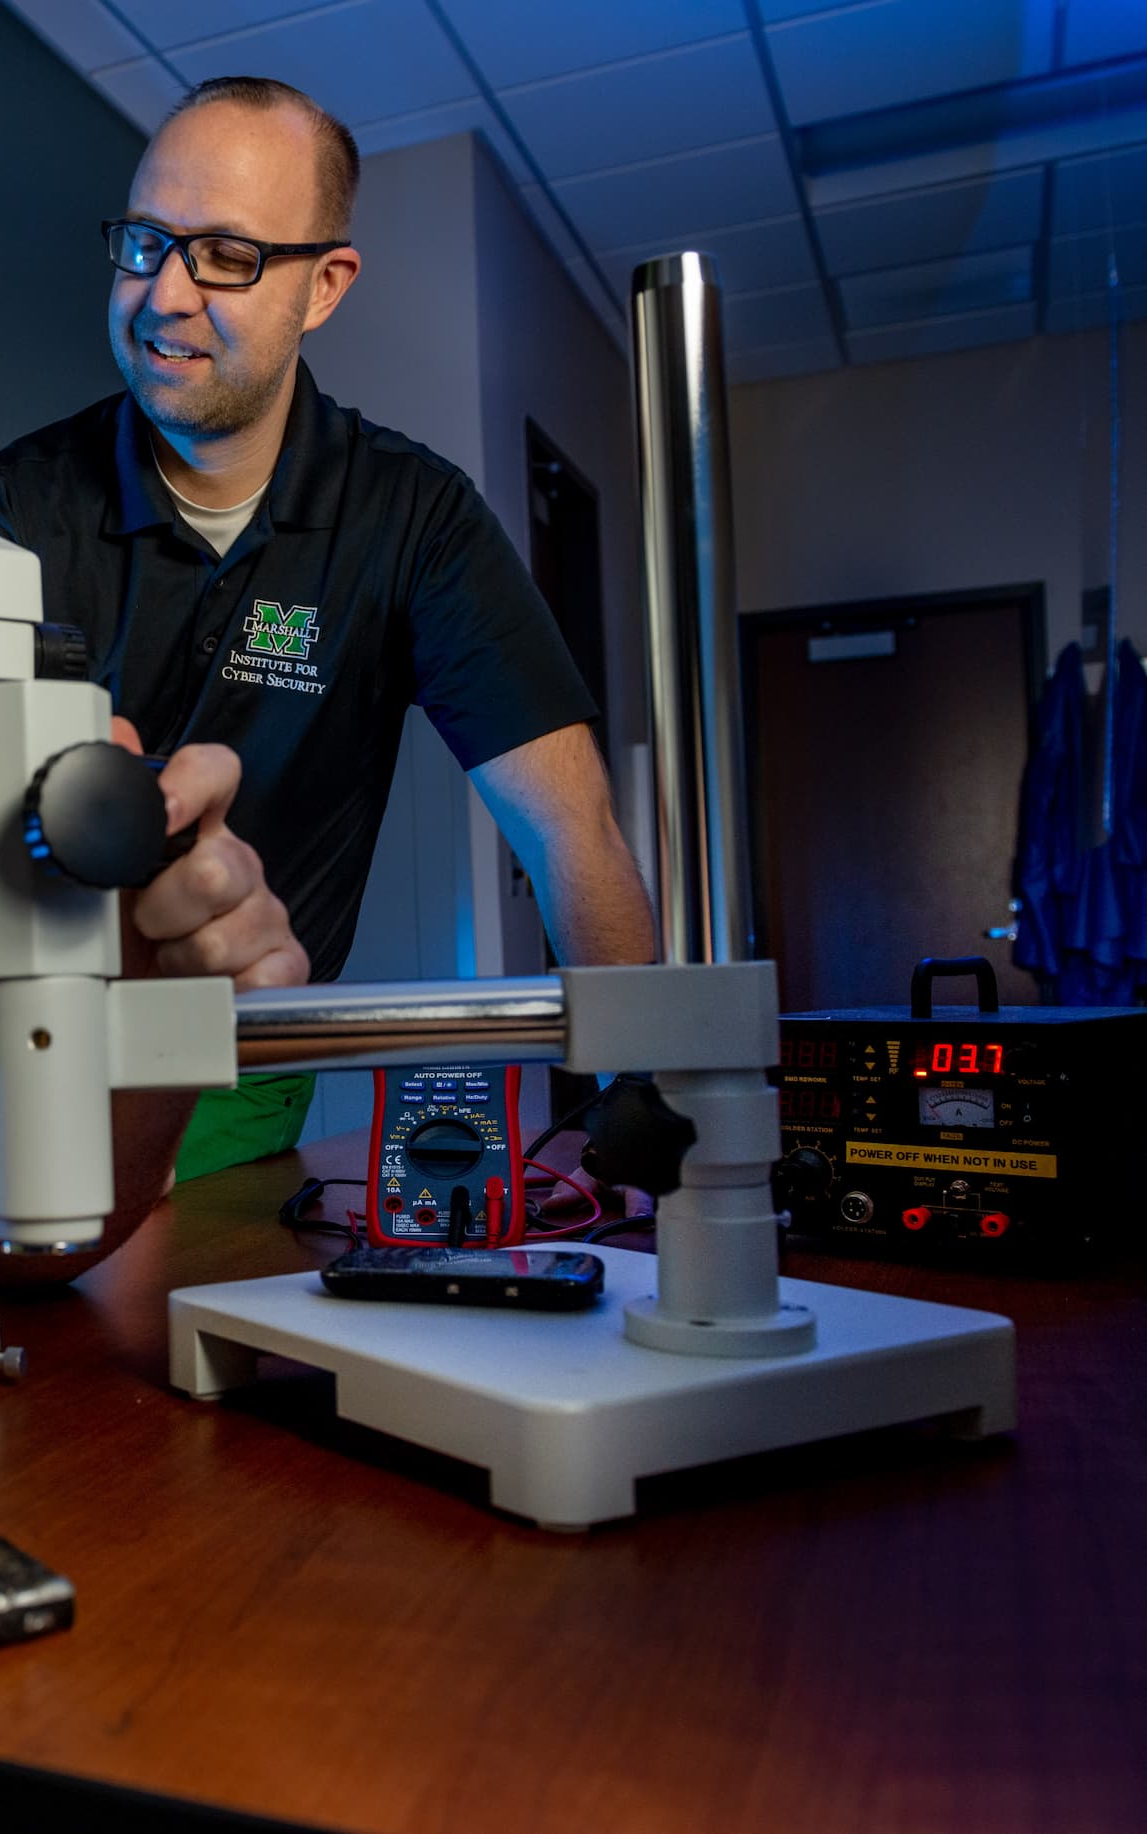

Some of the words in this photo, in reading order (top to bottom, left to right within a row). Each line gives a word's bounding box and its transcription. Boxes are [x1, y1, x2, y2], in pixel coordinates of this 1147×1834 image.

[252, 620, 312, 639] MARSHALL
[229, 650, 293, 672] INSTITUTE
[295, 663, 318, 677] FOR
[221, 666, 264, 684] CYBER
[266, 672, 327, 694] SECURITY
[1016, 1078, 1047, 1086] VOLTAGE
[1000, 1102, 1012, 1110] ON
[998, 1119, 1014, 1127] OFF
[1023, 1138, 1050, 1147] POWER
[385, 1155, 402, 1165] CE
[850, 1148, 893, 1160] POWER
[896, 1151, 920, 1161] OFF
[923, 1153, 960, 1165] WHEN
[963, 1156, 991, 1167] NOT
[993, 1157, 1007, 1168] IN
[1009, 1159, 1038, 1171] USE
